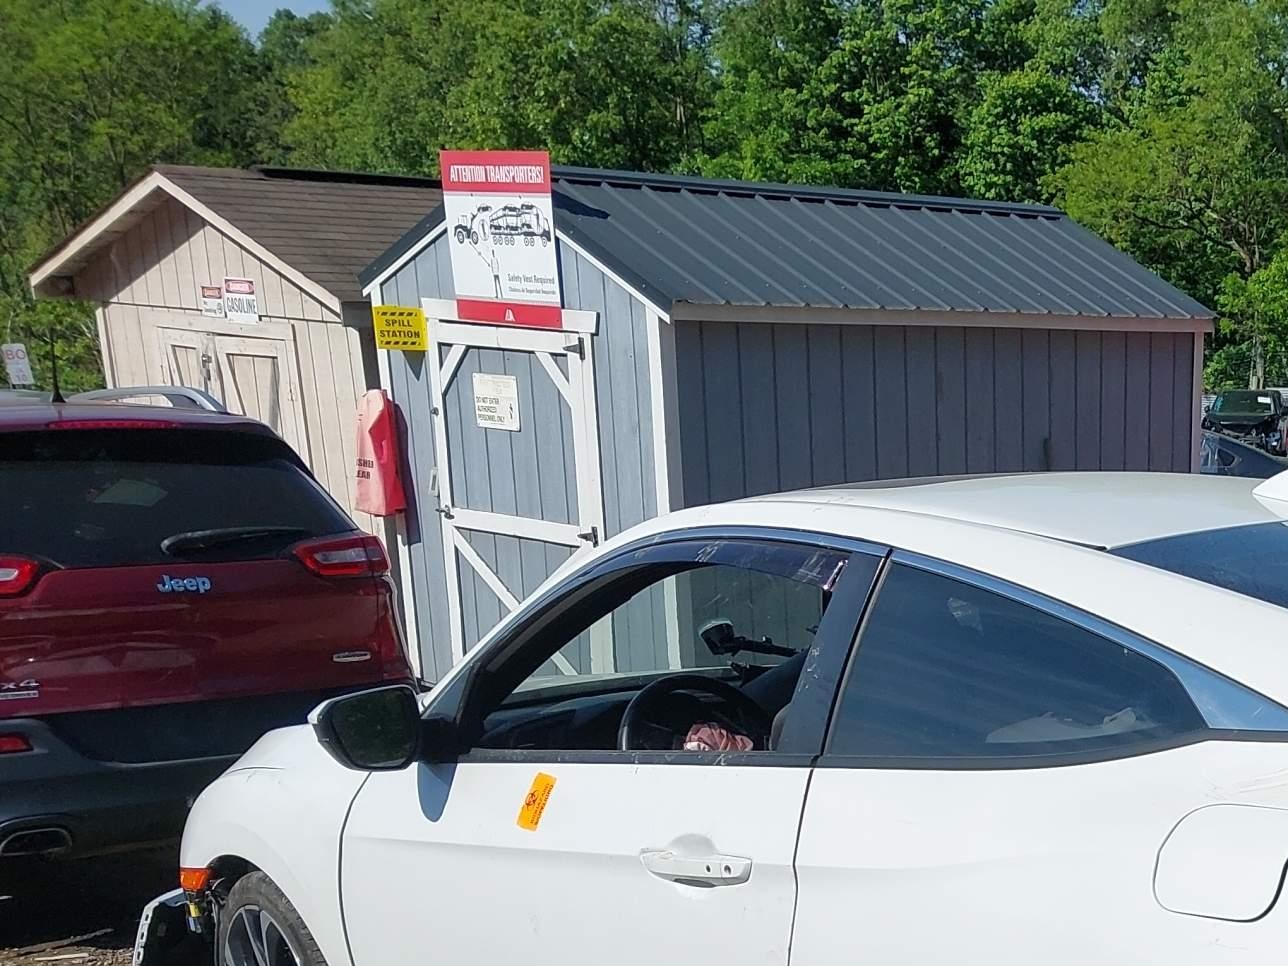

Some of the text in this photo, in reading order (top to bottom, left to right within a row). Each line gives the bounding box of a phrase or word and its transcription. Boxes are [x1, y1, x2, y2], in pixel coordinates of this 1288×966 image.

[450, 165, 544, 183] ATTENTION TRANSPORTERS!
[507, 273, 555, 285] Safety Vest Required
[226, 297, 257, 314] GASOLINE
[384, 319, 413, 327] SPILL
[379, 329, 421, 338] STATION
[156, 574, 211, 593] Jeep
